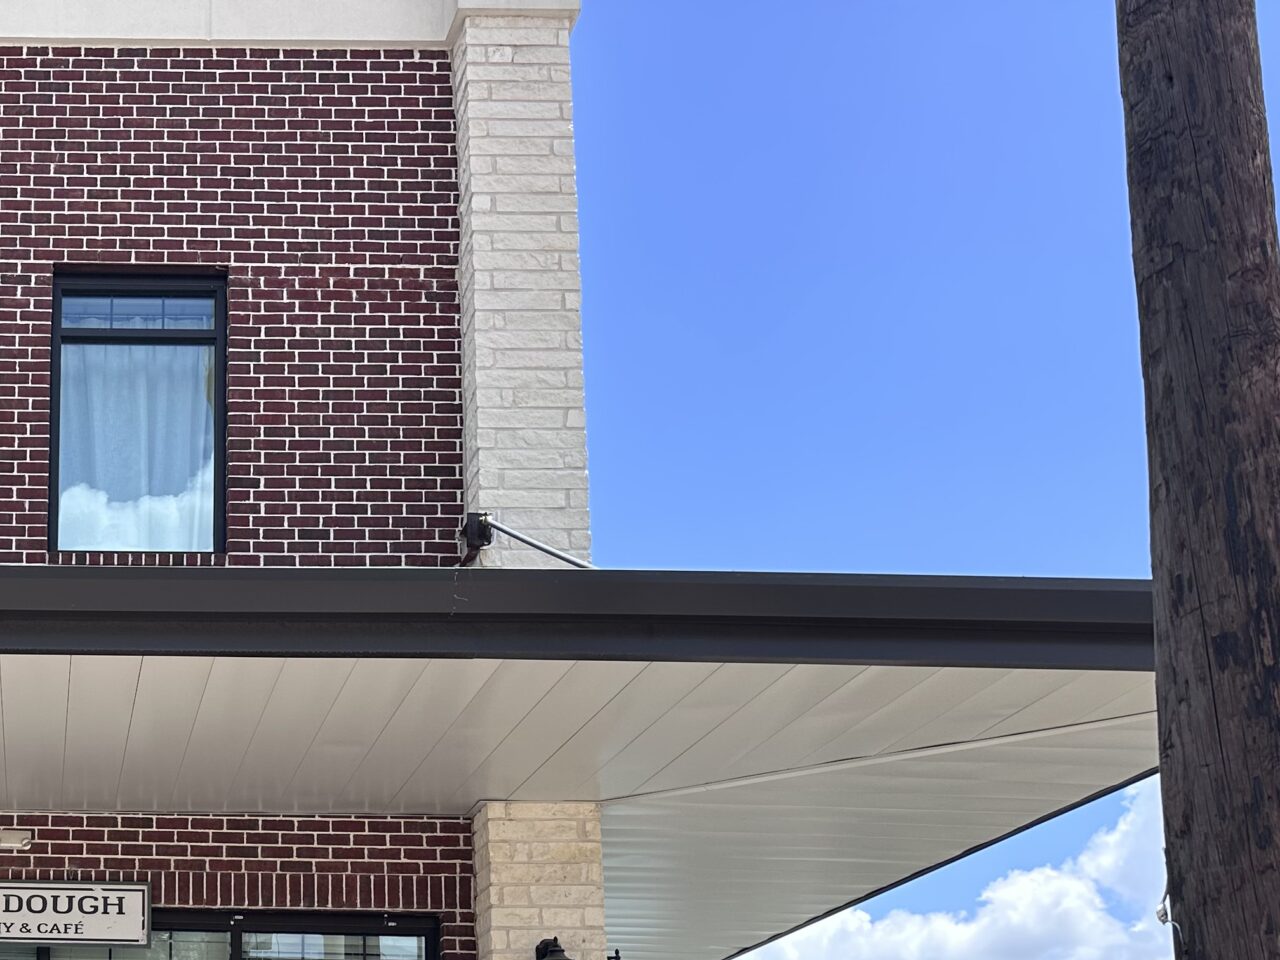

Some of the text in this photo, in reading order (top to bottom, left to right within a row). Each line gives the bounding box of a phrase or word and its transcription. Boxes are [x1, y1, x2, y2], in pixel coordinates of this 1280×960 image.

[3, 893, 126, 916] DOUGH
[19, 922, 32, 934] &
[37, 919, 84, 935] CAFÉ
